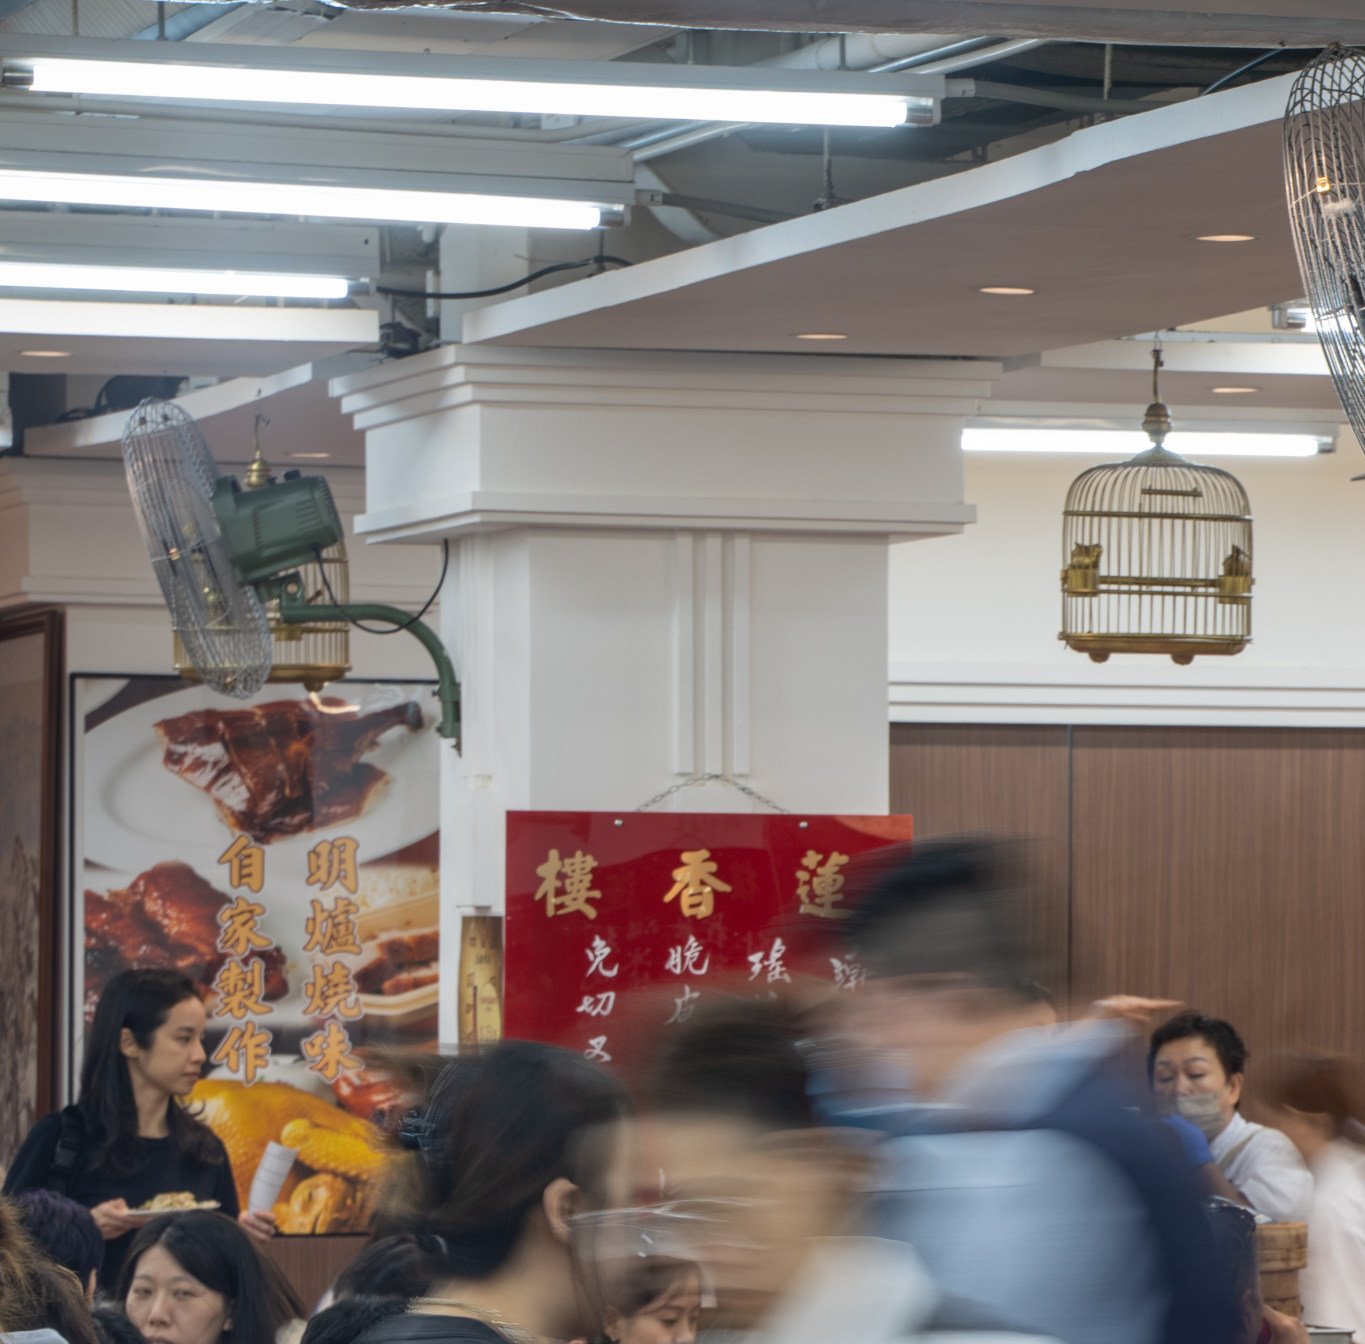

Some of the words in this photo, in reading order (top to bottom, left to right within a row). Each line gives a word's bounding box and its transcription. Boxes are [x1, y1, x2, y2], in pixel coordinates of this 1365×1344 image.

[212, 834, 274, 1086] 自家製作
[303, 837, 365, 1082] 明爐燒味
